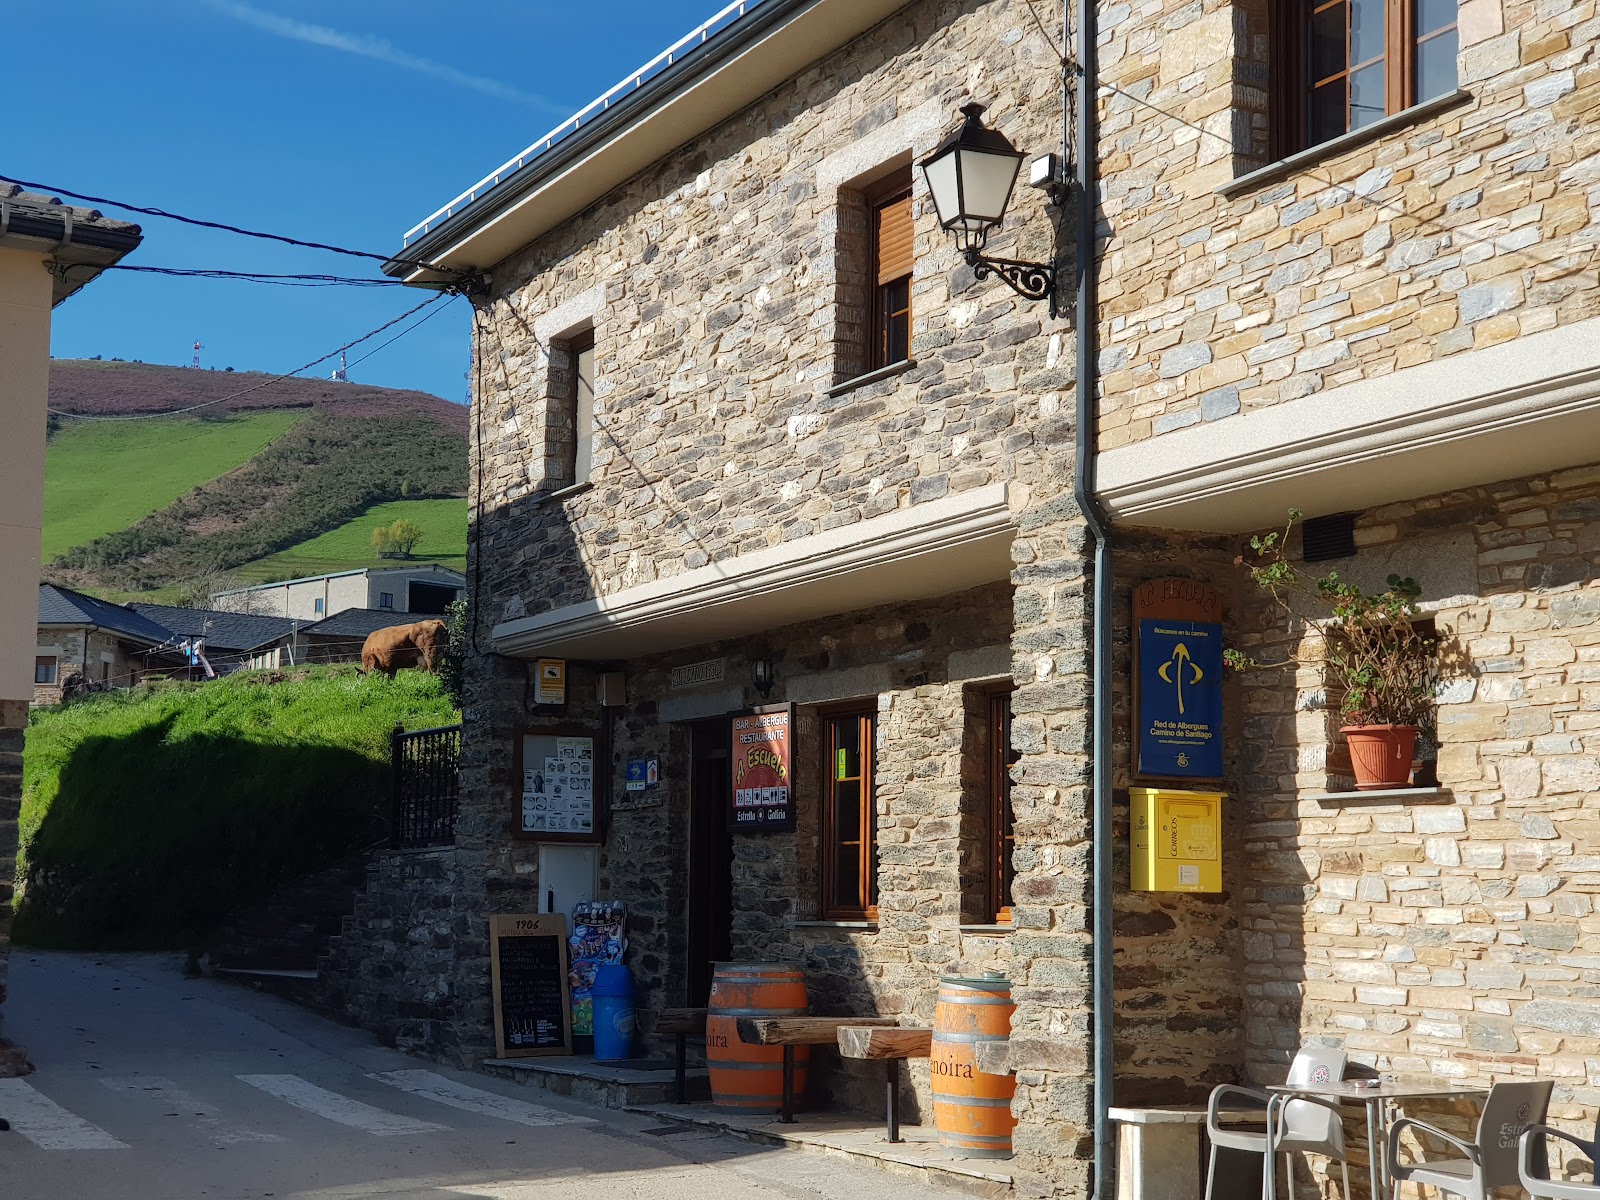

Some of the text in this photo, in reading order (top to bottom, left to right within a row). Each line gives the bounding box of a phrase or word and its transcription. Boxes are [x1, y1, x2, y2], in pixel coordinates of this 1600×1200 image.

[1140, 578, 1217, 613] LA ESCUELA
[736, 720, 749, 730] BAR
[754, 714, 788, 728] ALBERGUE
[1154, 720, 1168, 728] Red
[1177, 722, 1209, 731] Albergues
[739, 730, 784, 744] RESTAURANTE
[1150, 728, 1213, 739] Camino de Santiago
[736, 746, 787, 786] A Escuela
[737, 809, 786, 821] Estrella Galicia
[1170, 817, 1178, 857] CORREOS
[516, 919, 540, 929] 1906
